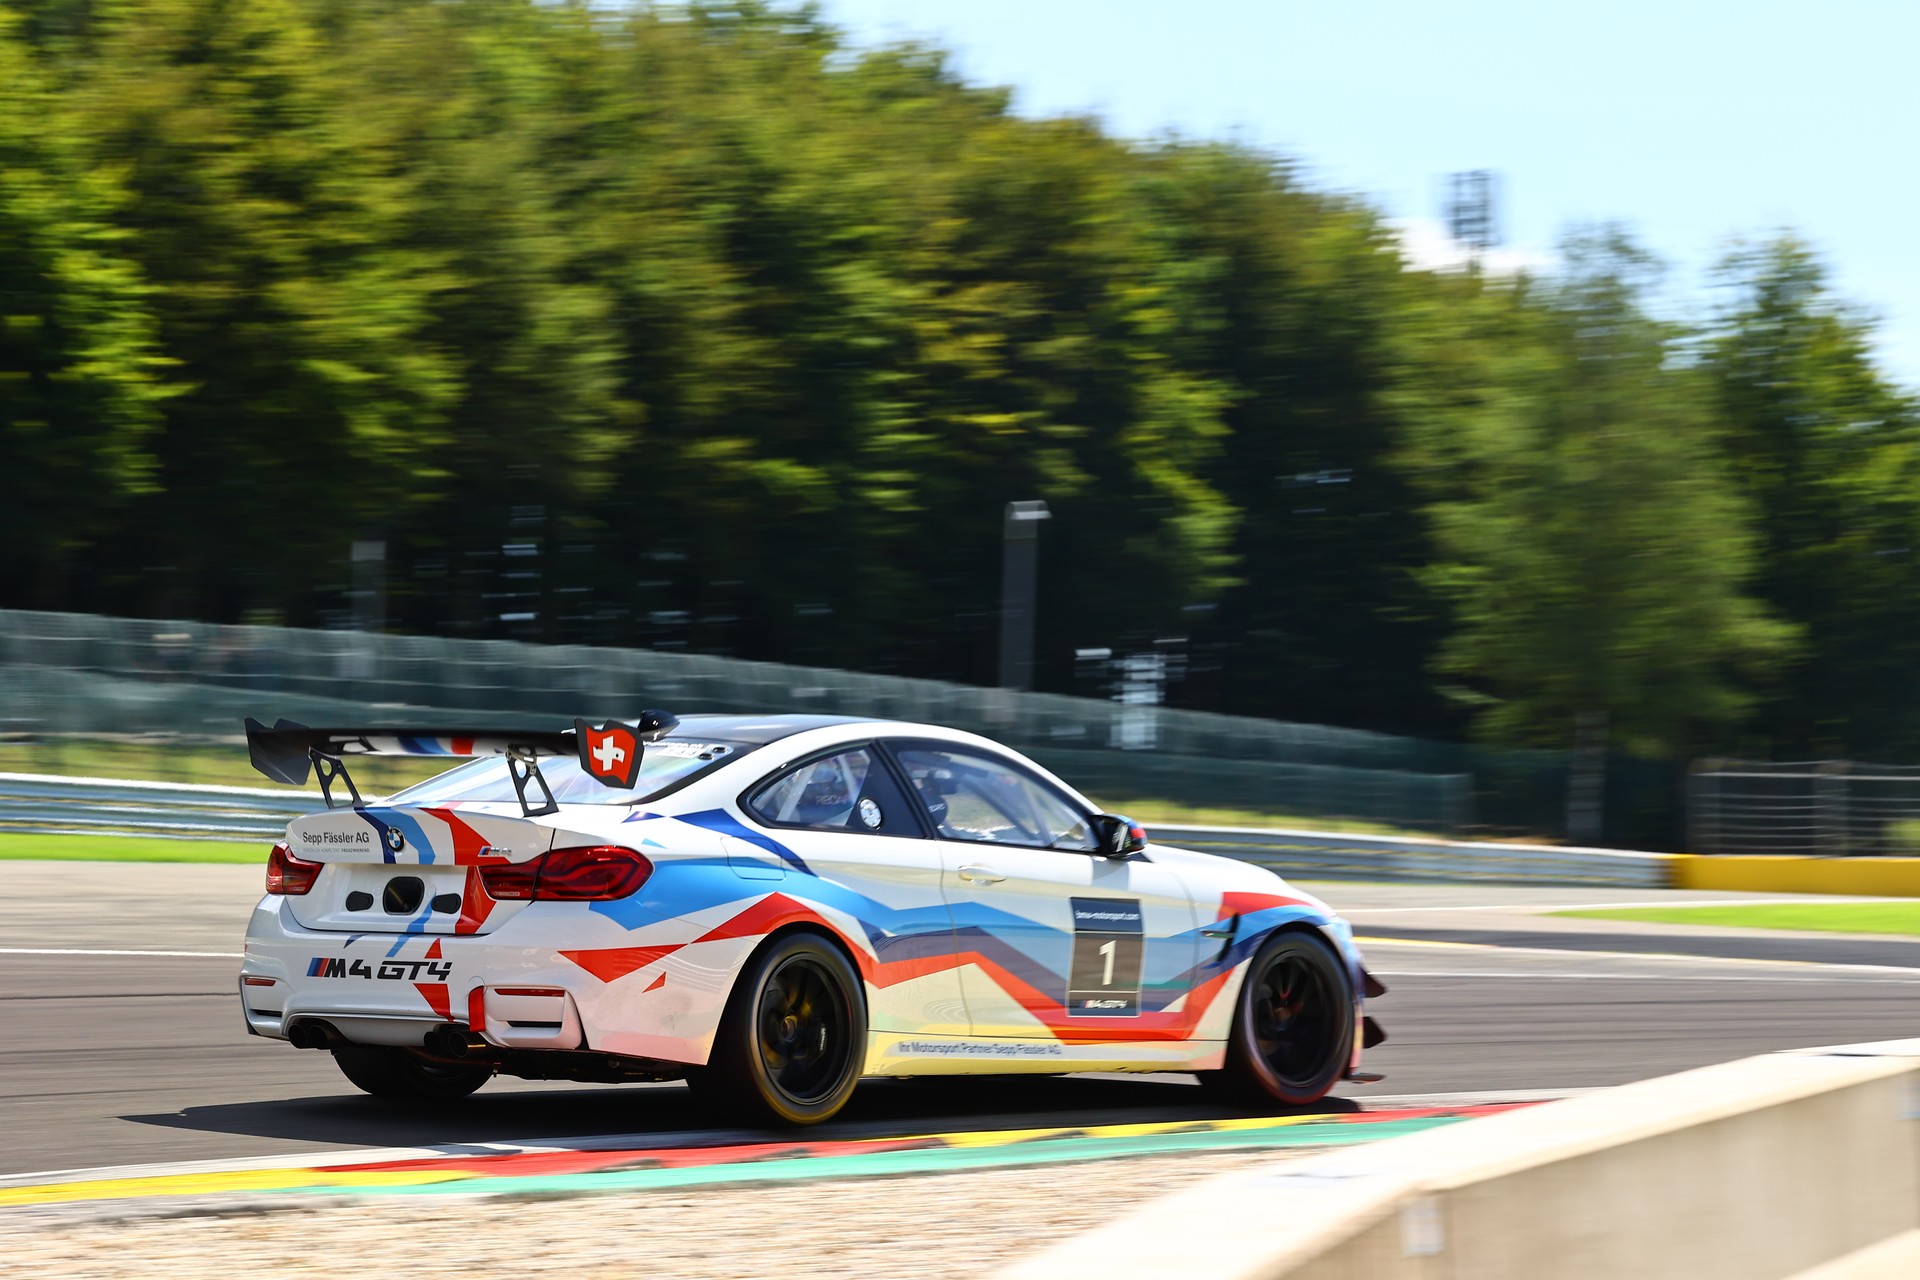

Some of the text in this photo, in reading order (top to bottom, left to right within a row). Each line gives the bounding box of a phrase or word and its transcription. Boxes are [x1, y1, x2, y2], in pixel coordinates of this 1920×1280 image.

[302, 832, 370, 845] Sepp Fässler AG
[377, 960, 453, 981] GT4
[1099, 939, 1117, 986] 1
[911, 1042, 959, 1055] Motorsport
